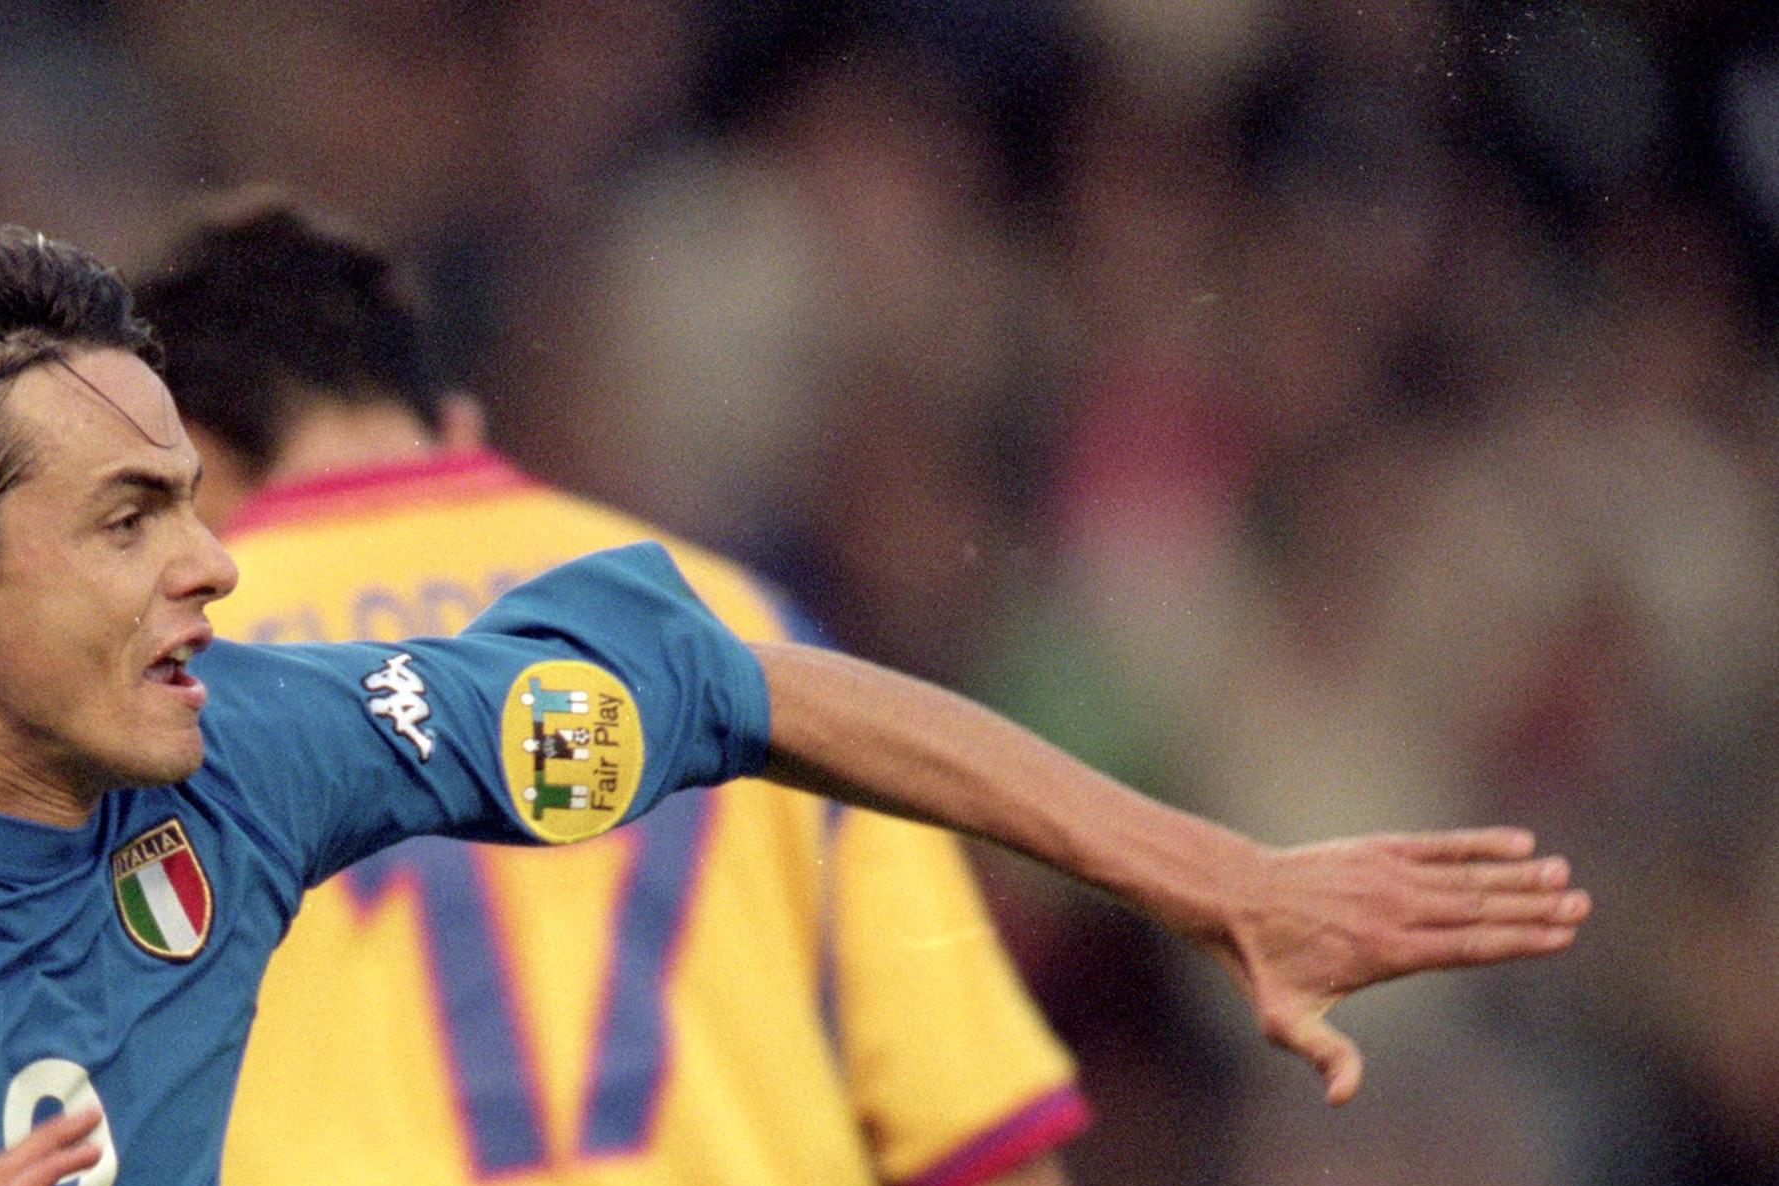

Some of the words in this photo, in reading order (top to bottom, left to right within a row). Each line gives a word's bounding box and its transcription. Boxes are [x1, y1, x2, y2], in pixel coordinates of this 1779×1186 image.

[594, 693, 624, 747] Play
[590, 757, 619, 812] Fair
[114, 831, 179, 879] ITALIA
